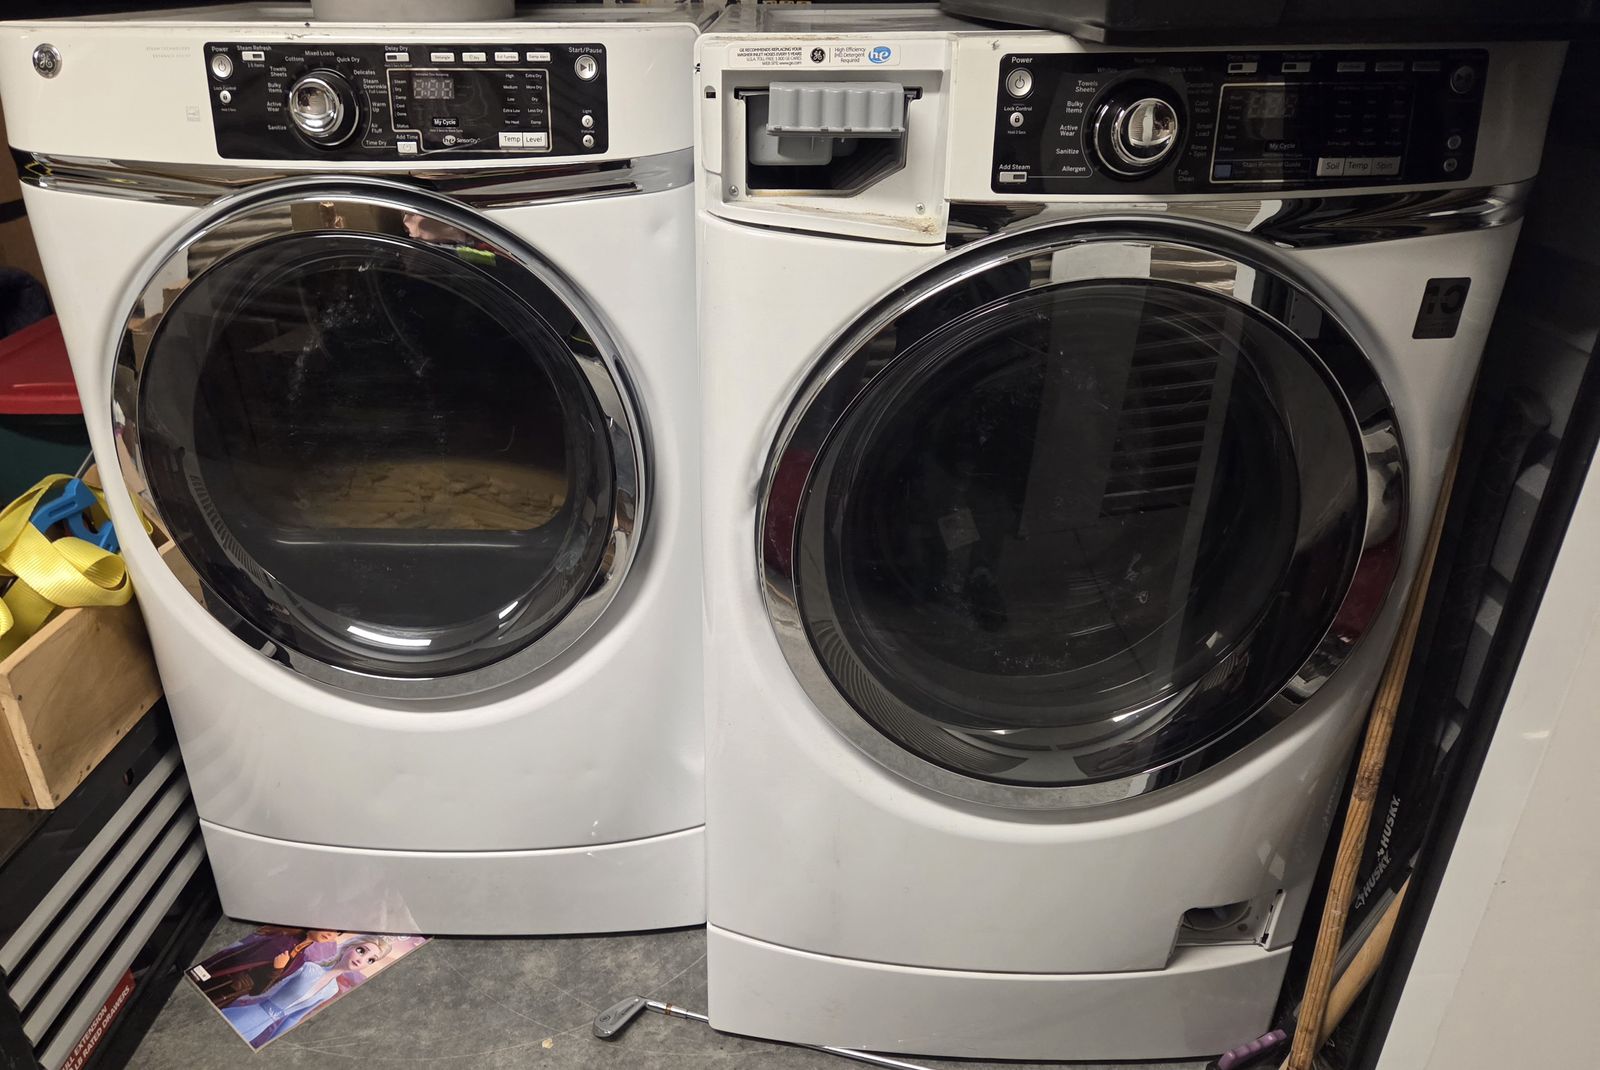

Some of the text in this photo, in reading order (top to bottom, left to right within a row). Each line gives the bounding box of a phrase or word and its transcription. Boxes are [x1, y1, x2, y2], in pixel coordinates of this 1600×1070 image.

[568, 46, 603, 54] Start/Pause
[1011, 56, 1033, 64] Power
[433, 118, 456, 126] My Cycle
[503, 135, 521, 143] Temp
[525, 135, 543, 143] Level
[1269, 143, 1278, 151] My
[1061, 165, 1086, 173] Allergen
[1326, 161, 1341, 170] Soil
[1348, 162, 1369, 171] Temp
[1375, 161, 1393, 171] Spin
[82, 1027, 103, 1058] RATED
[102, 985, 130, 1029] DRAWERS
[74, 1005, 107, 1056] EXTENSION
